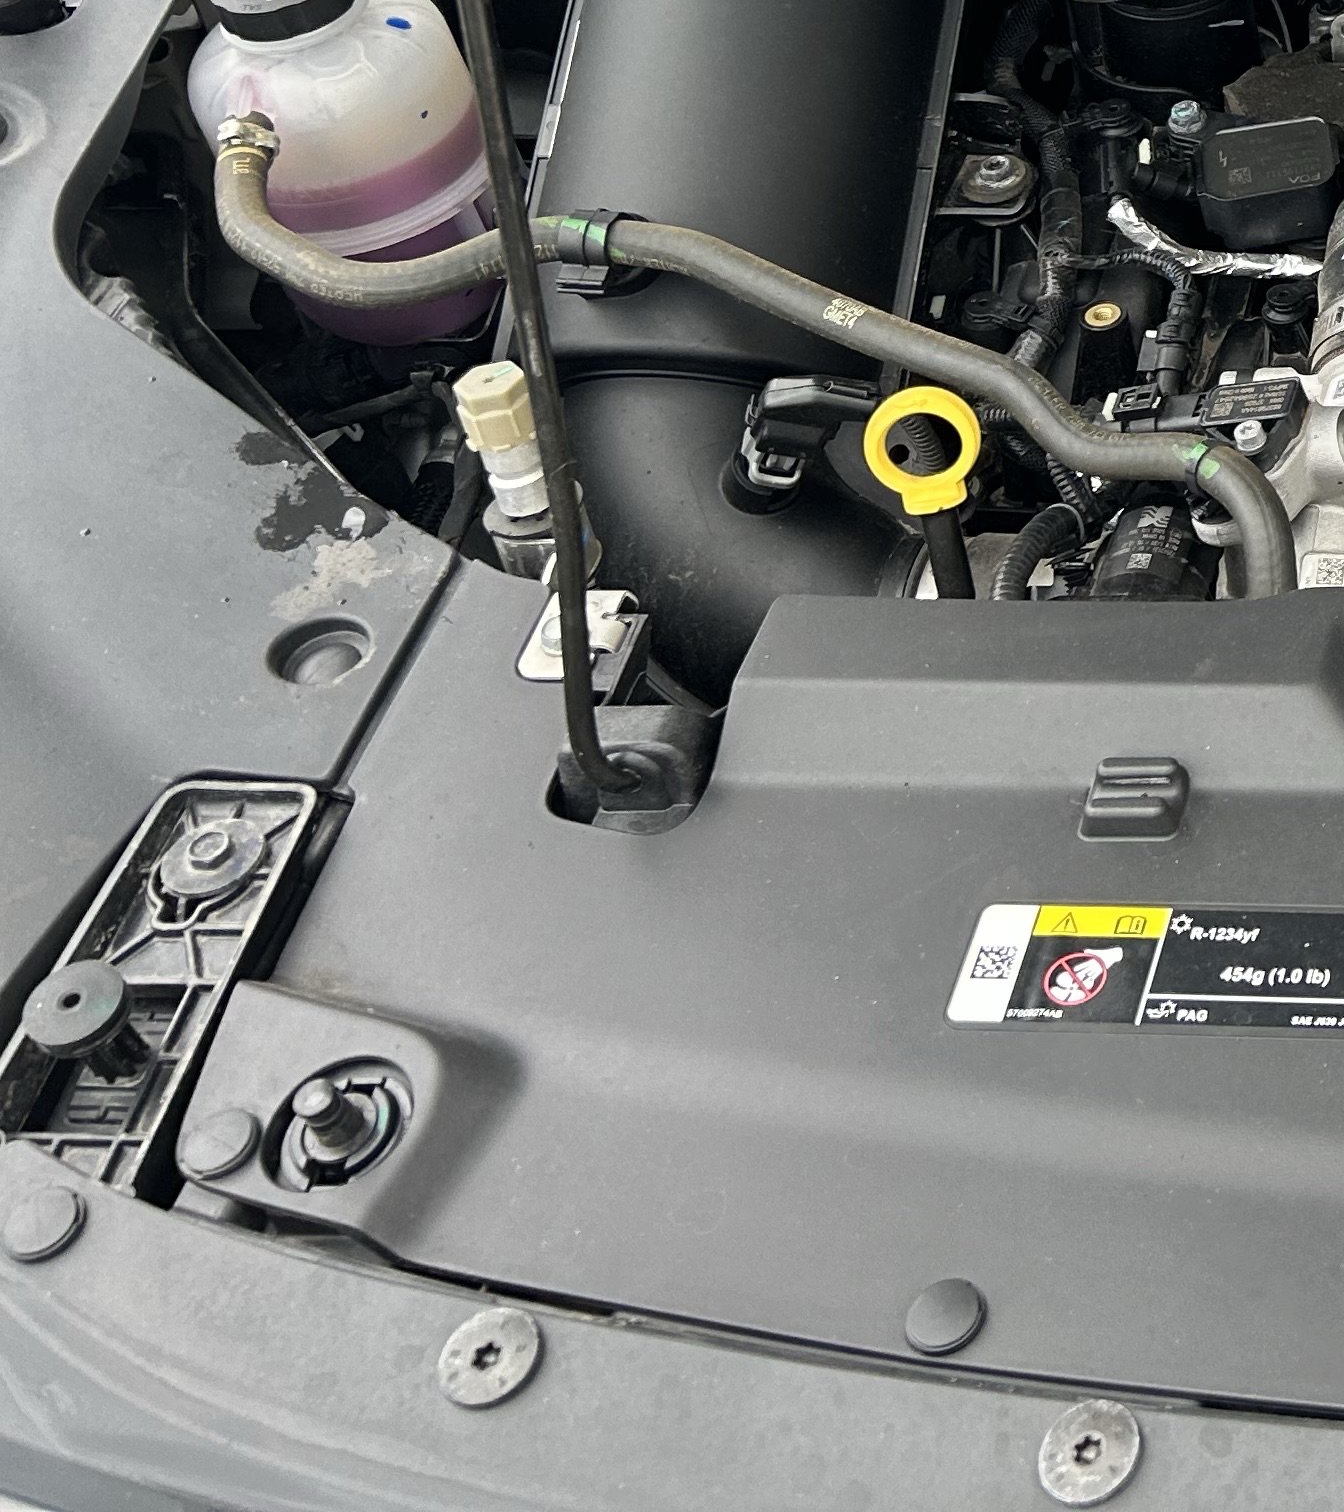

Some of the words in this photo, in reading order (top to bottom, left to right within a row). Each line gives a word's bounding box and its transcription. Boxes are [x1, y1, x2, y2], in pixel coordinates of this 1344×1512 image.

[1190, 925, 1261, 944] R-1234yf
[1220, 965, 1266, 986] 454g
[1269, 967, 1304, 987] (1.0
[1305, 968, 1332, 988] lb)
[1177, 1007, 1209, 1023] PAG
